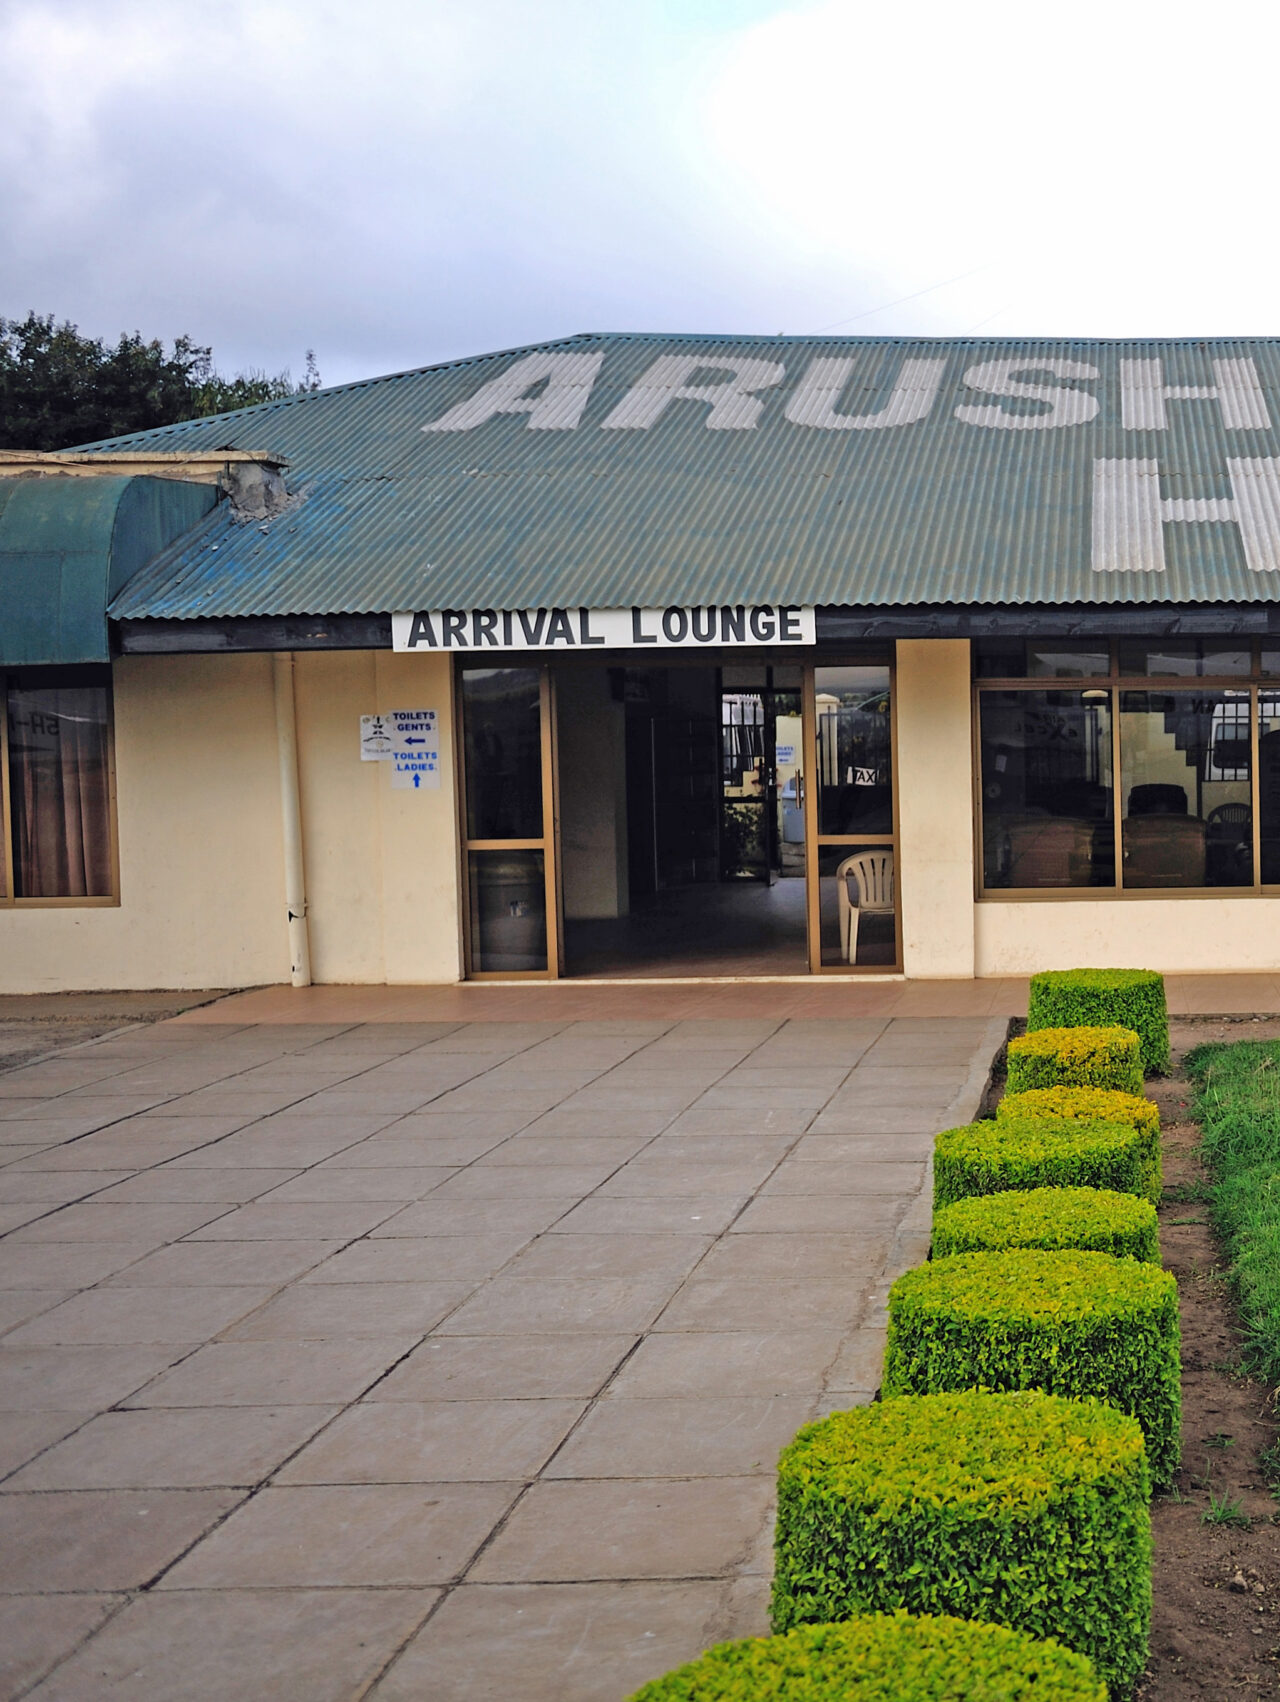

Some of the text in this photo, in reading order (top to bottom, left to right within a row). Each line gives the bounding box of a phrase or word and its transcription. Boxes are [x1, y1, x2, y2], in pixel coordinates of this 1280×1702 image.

[407, 604, 803, 647] ARRIVAL LOUNGE
[393, 711, 435, 720] TOILETS
[397, 723, 432, 731] GENTS
[393, 752, 437, 760] TOILETS
[397, 763, 434, 771] LADIES
